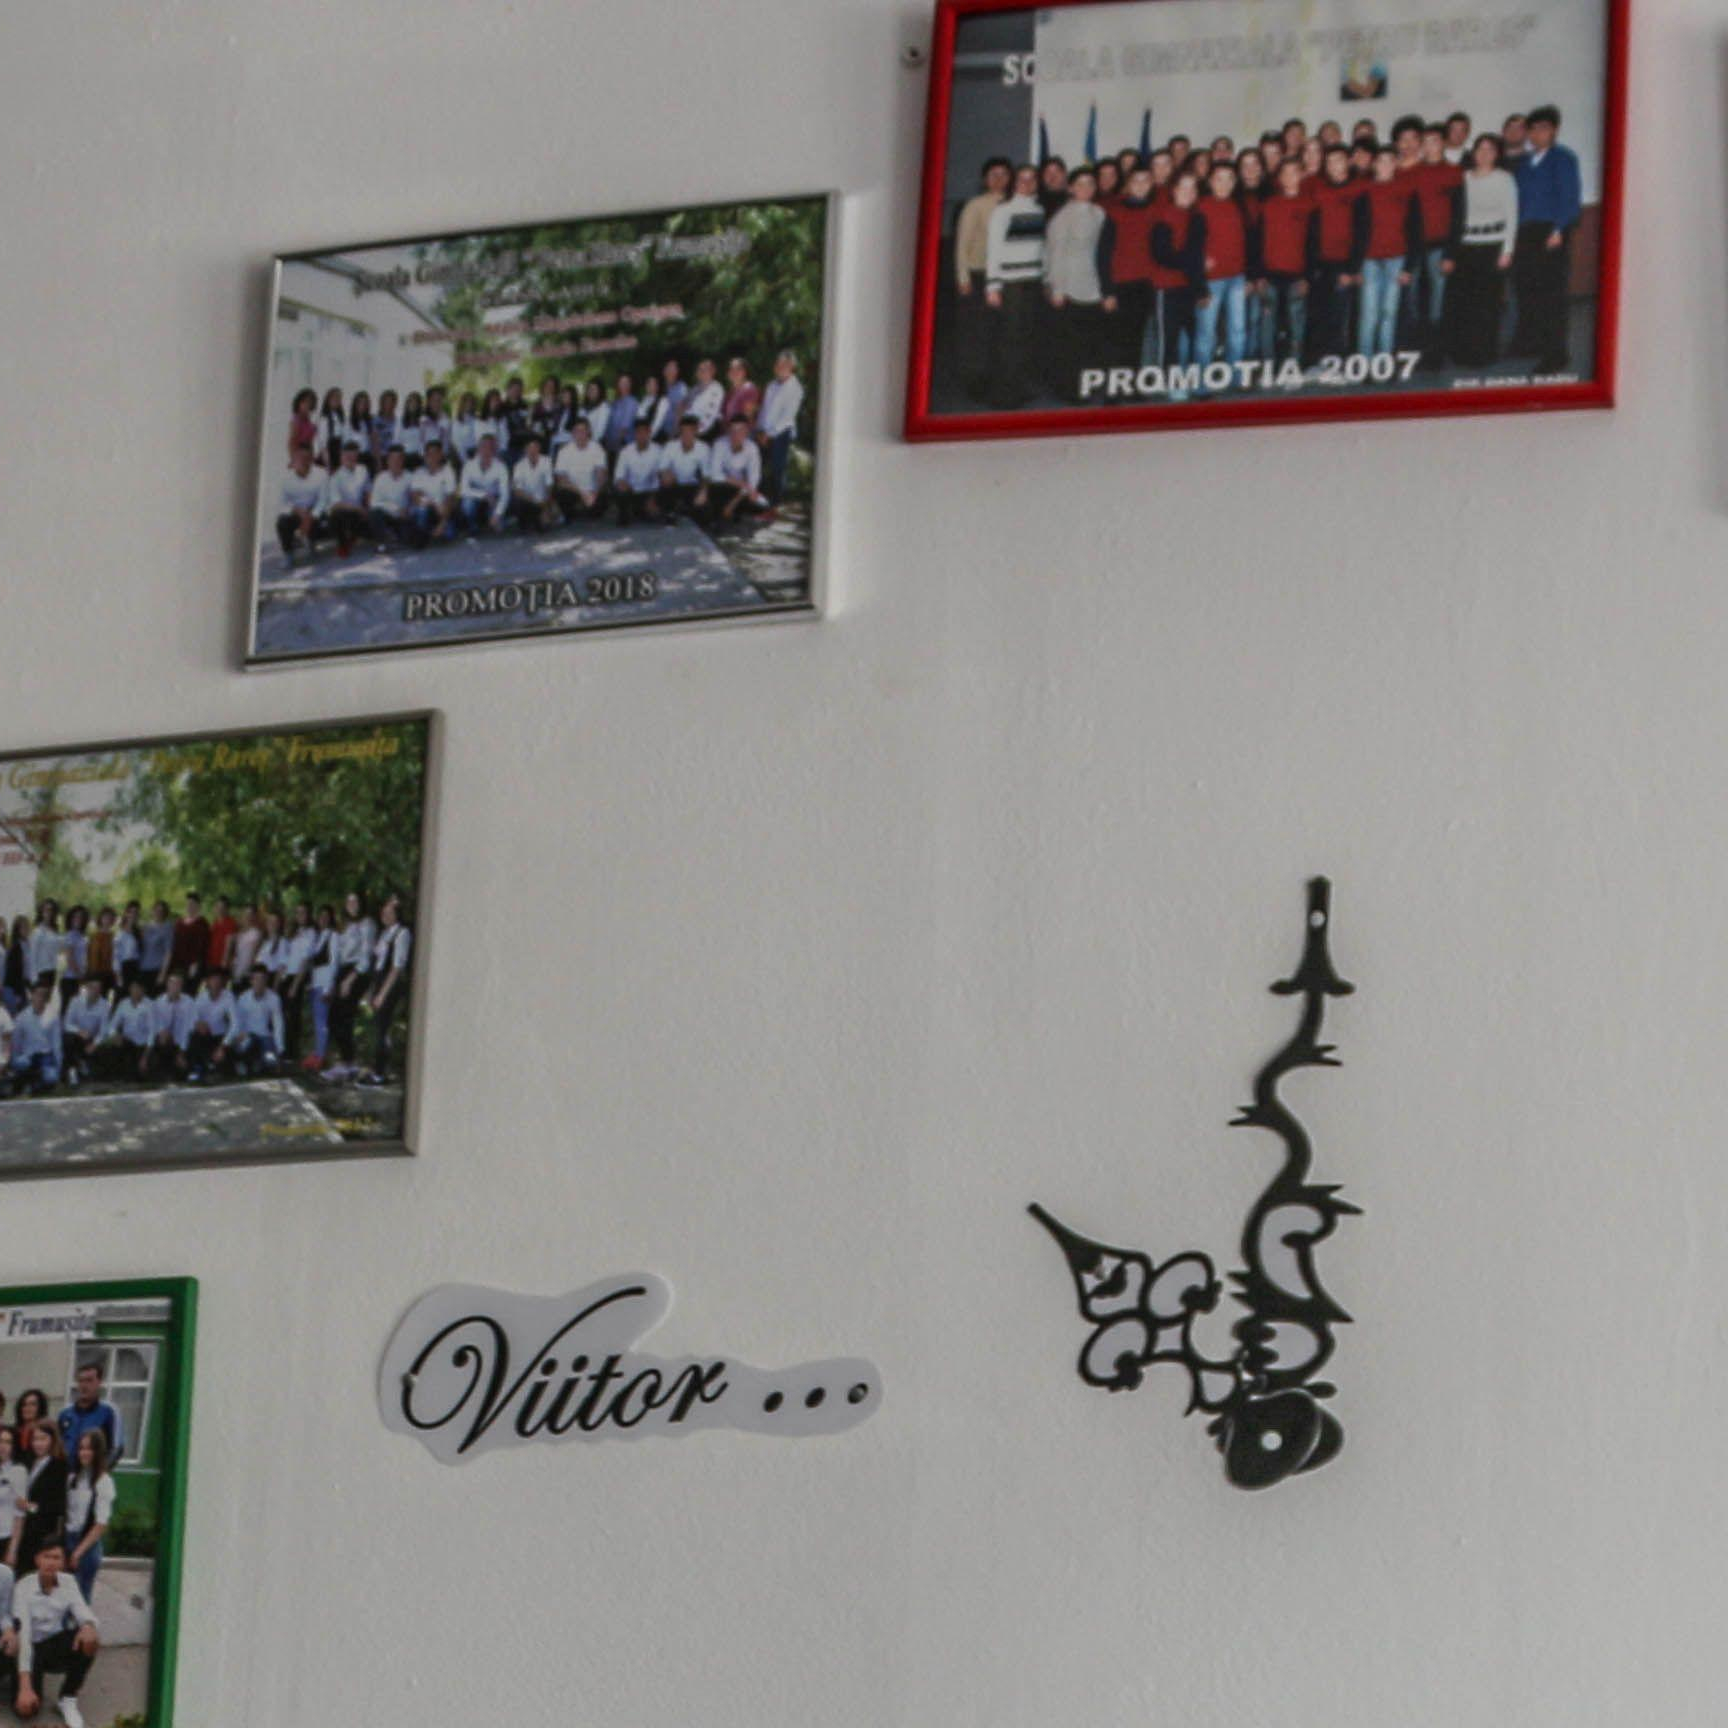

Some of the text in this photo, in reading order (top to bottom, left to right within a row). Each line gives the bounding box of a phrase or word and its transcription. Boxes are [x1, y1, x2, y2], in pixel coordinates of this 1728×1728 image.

[1080, 350, 1421, 396] PROMOTIA 2007
[586, 571, 656, 603] 2018
[401, 1286, 728, 1454] Viitor
